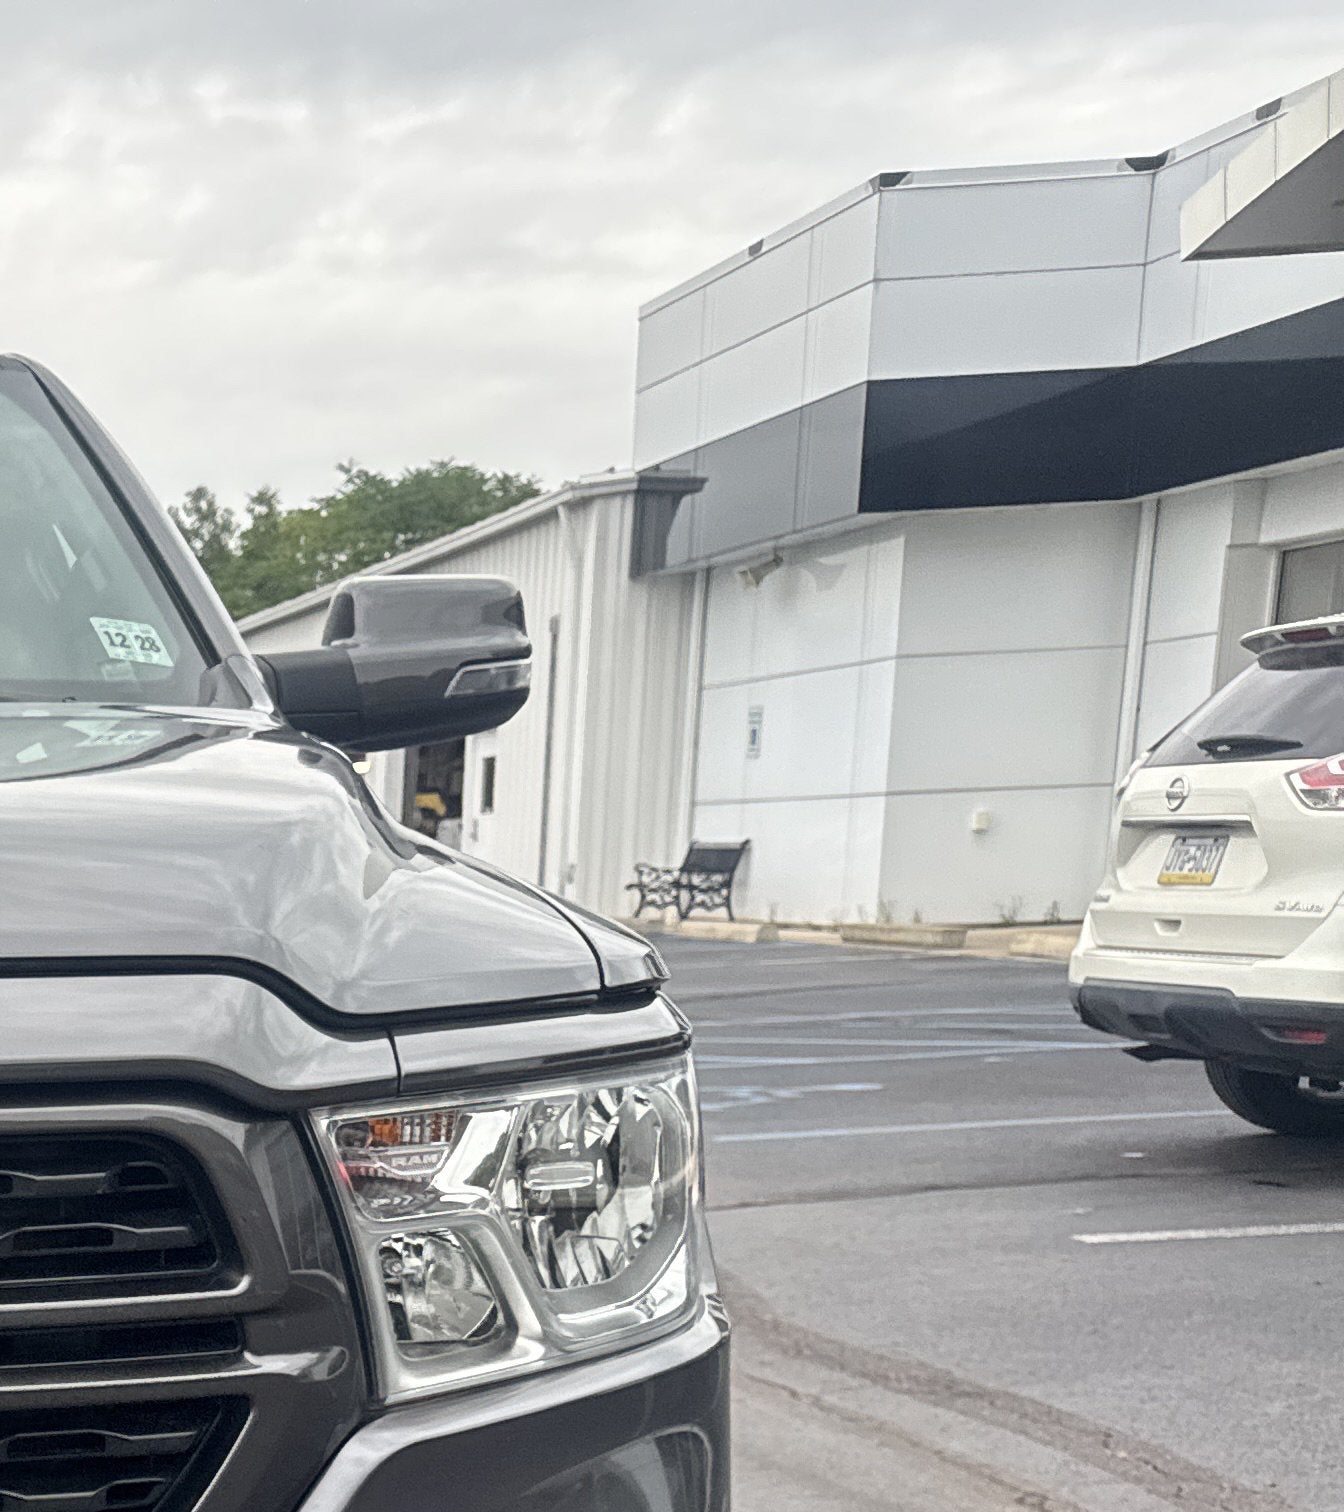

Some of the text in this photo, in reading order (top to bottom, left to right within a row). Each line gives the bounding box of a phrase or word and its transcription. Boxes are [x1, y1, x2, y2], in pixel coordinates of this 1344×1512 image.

[104, 631, 160, 652] 12 28
[392, 1154, 439, 1167] RAM
